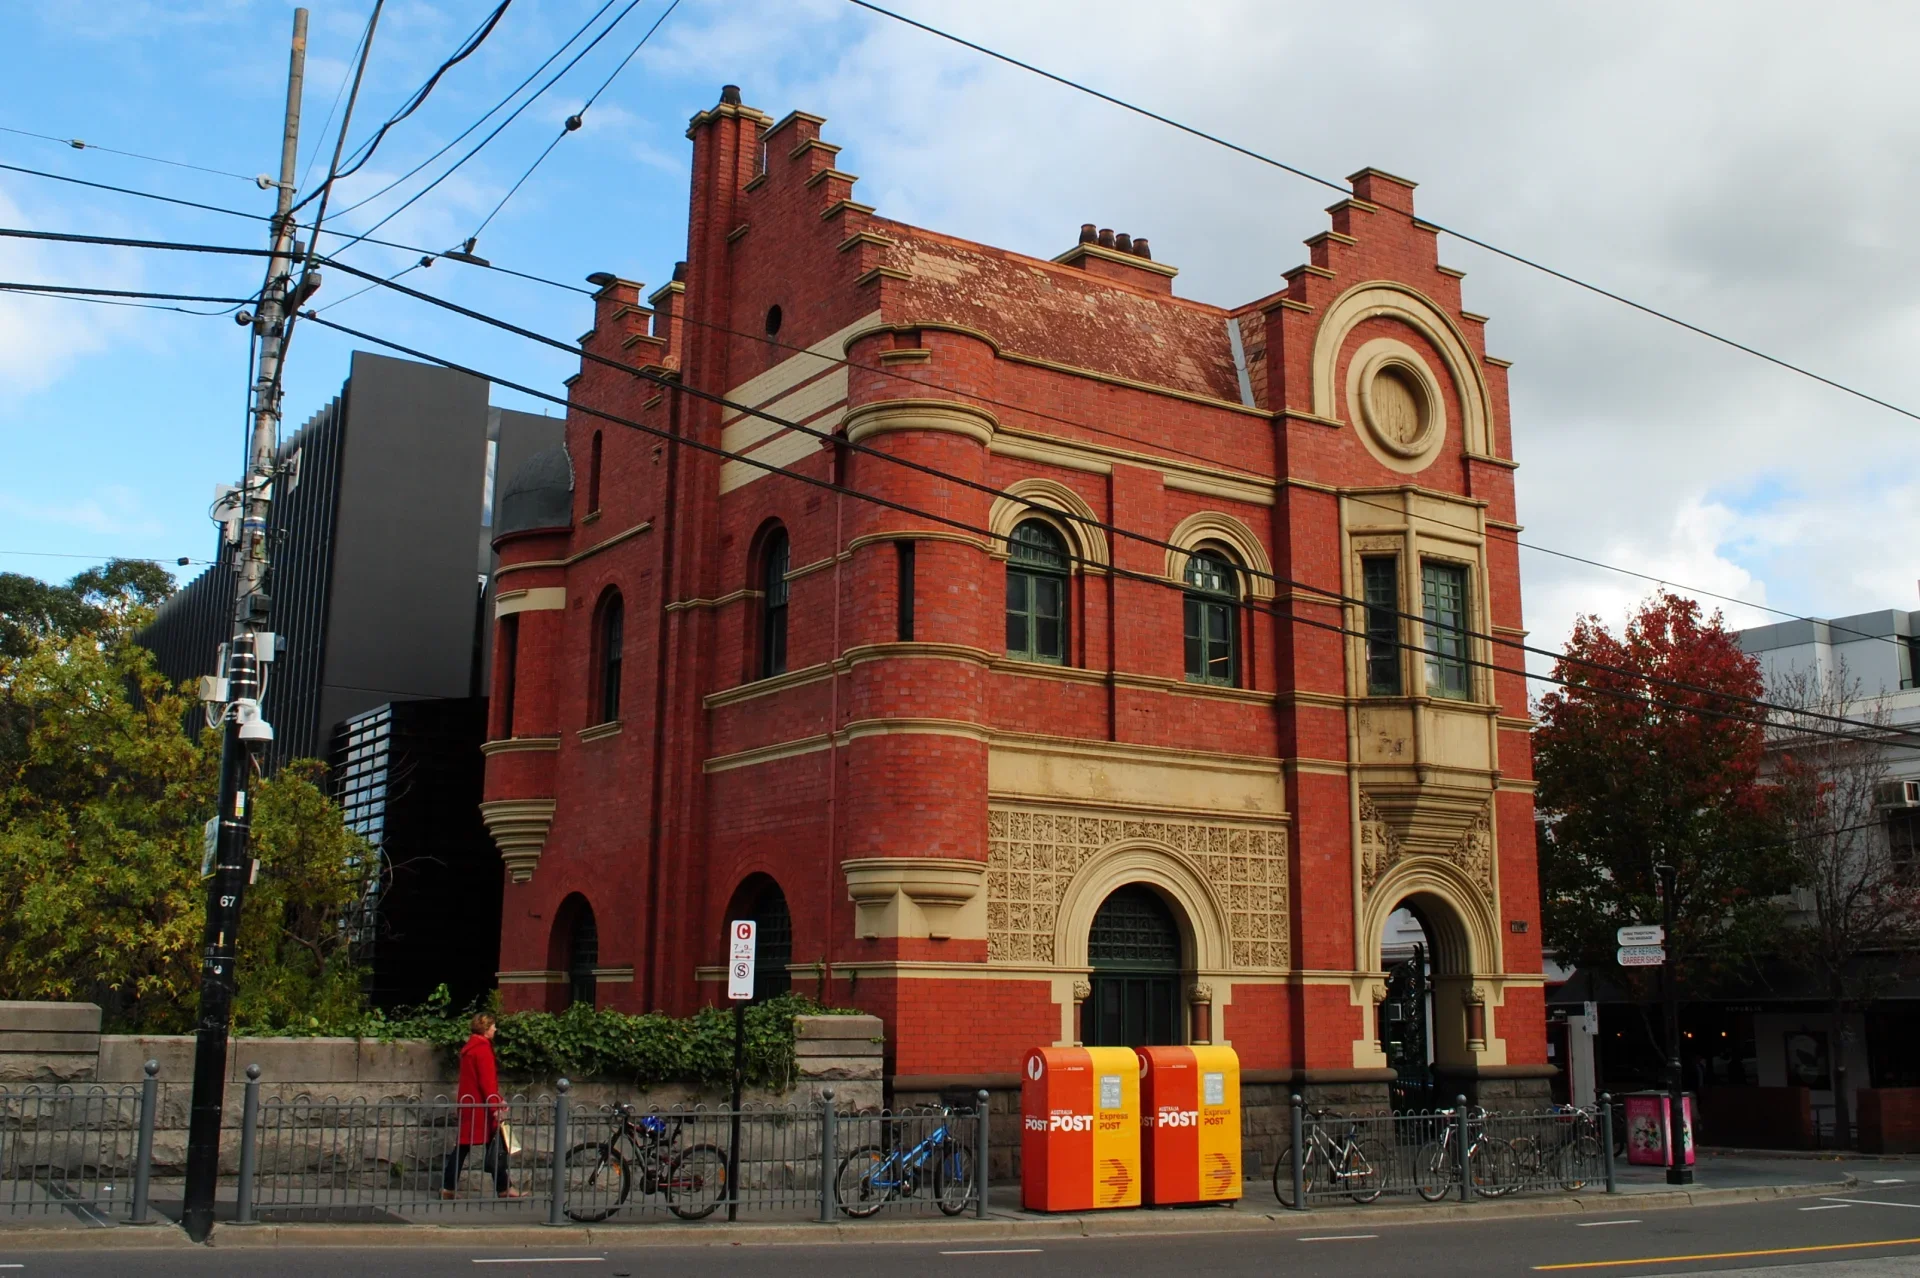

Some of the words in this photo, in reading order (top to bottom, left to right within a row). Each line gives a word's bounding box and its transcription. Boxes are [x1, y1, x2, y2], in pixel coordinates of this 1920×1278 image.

[220, 896, 236, 907] 67
[738, 924, 750, 939] C
[1638, 946, 1661, 955] REPAIRS
[1623, 956, 1645, 965] BARBER
[1646, 956, 1661, 964] SHOP
[1100, 1112, 1128, 1121] Express
[1204, 1108, 1230, 1117] Express
[1050, 1115, 1094, 1131] POST
[1158, 1111, 1199, 1128] POST
[1204, 1117, 1224, 1125] POST
[1025, 1118, 1048, 1131] POST
[1100, 1121, 1121, 1130] POST
